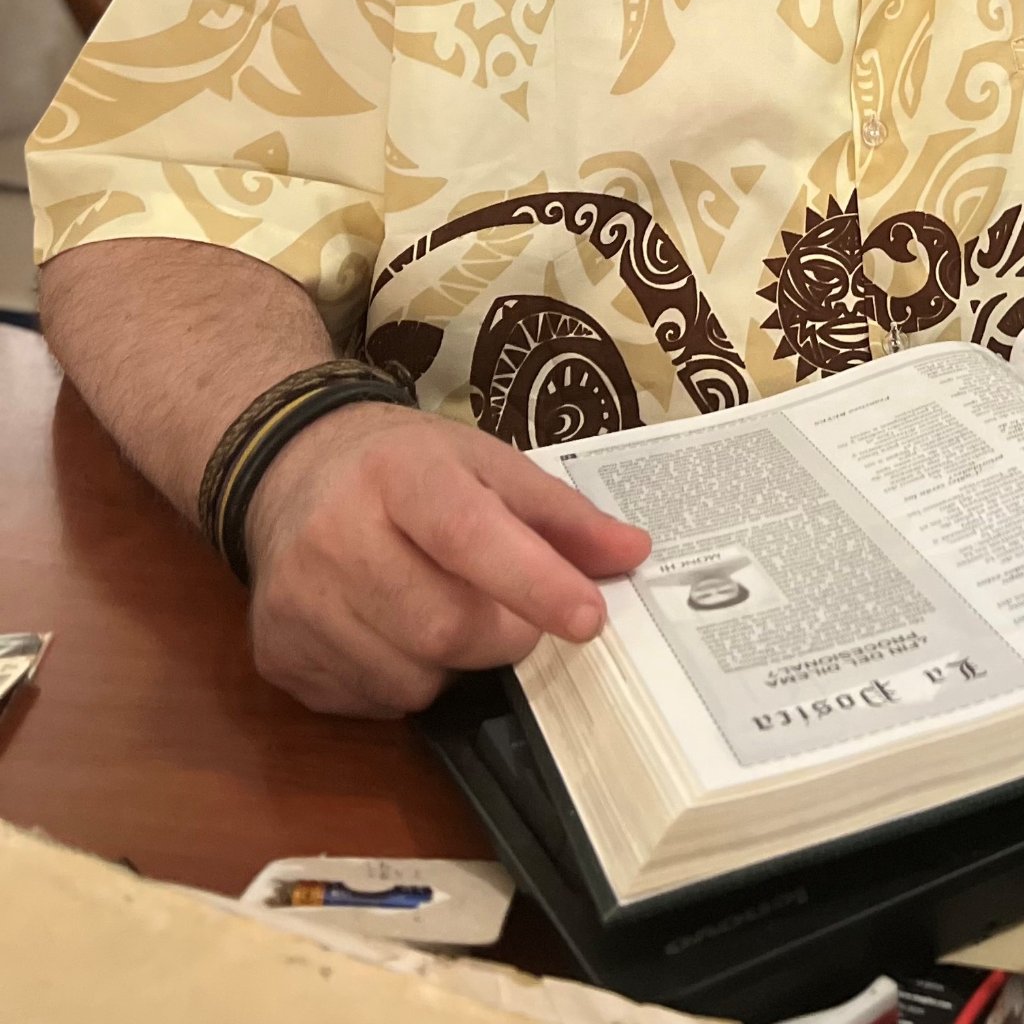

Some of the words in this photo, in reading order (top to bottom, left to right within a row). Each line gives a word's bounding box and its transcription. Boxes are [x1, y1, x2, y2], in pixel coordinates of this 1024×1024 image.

[765, 630, 919, 678] PROCESIONAL?
[848, 647, 884, 670] DEL
[887, 634, 929, 658] ¿FIN
[763, 660, 842, 691] DILEMA
[921, 656, 988, 685] La
[750, 678, 902, 734] Posica
